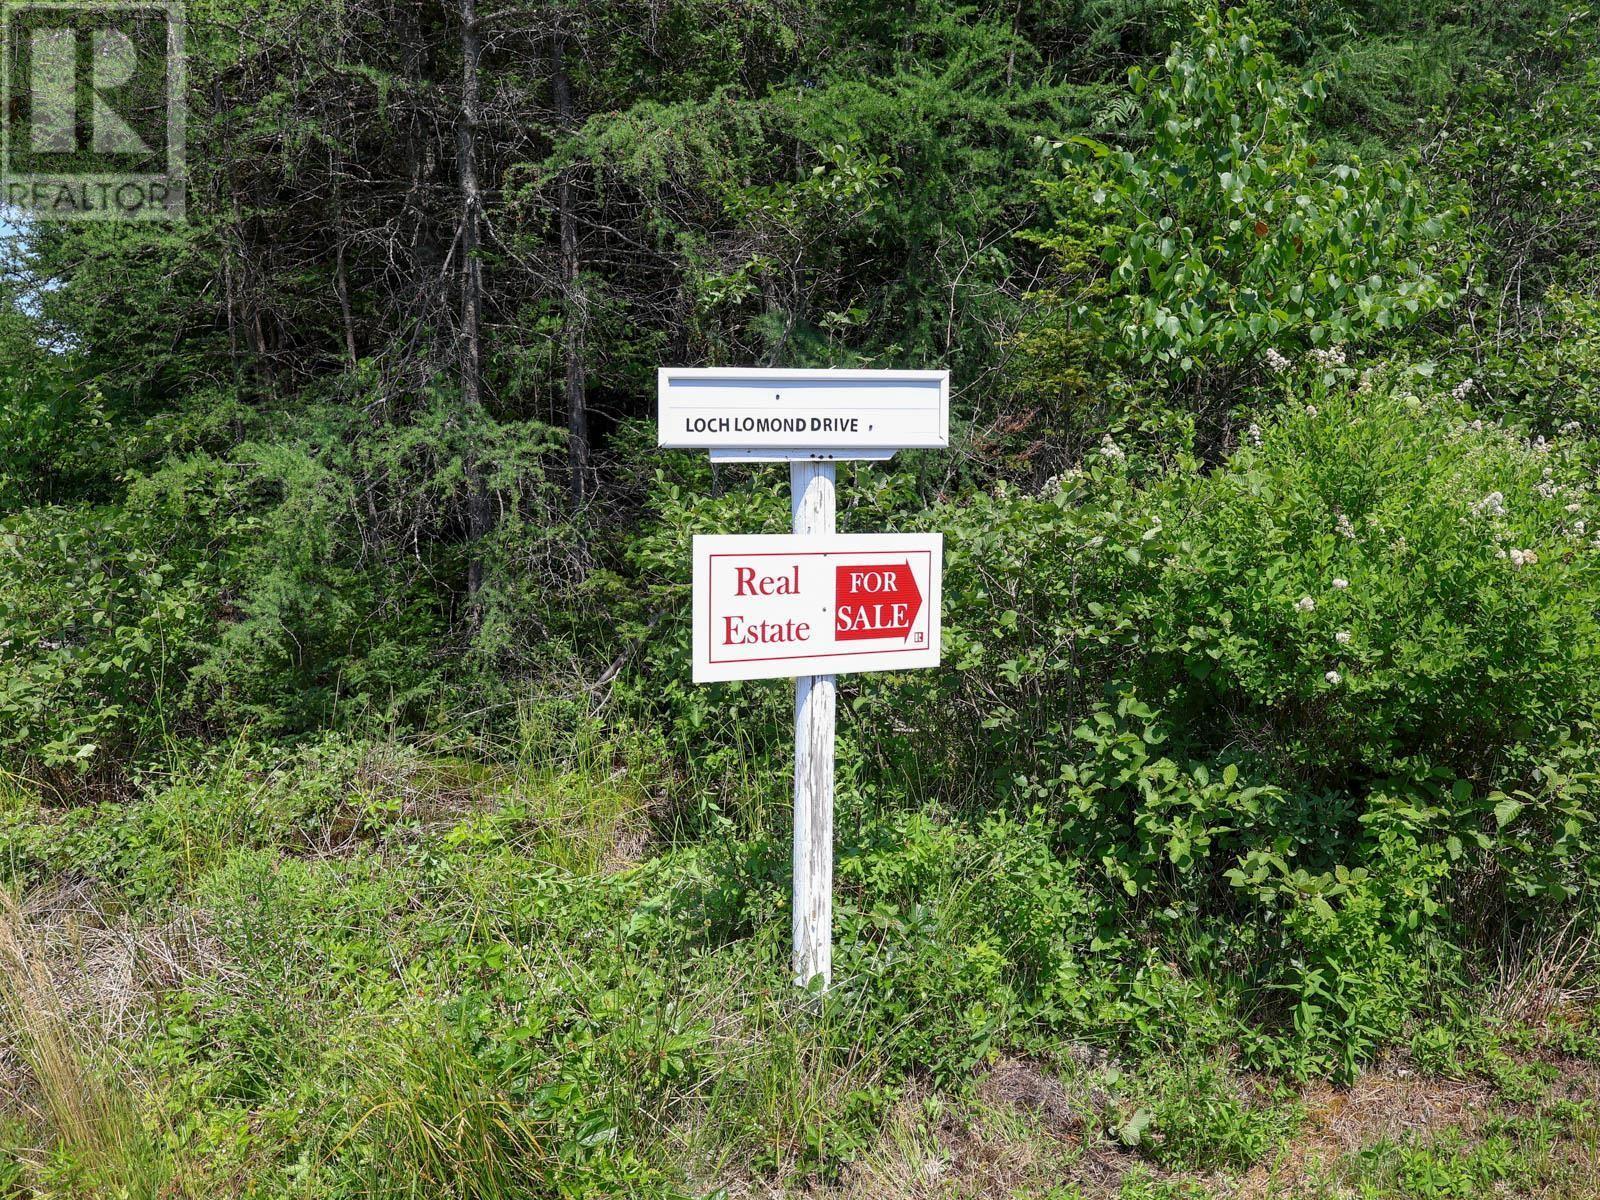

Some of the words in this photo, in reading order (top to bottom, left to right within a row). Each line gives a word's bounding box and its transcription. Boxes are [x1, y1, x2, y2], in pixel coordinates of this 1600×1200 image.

[686, 417, 730, 433] LOCH
[734, 417, 807, 433] LOMOND
[810, 417, 859, 433] DRIVE
[734, 565, 801, 597] Real
[849, 571, 899, 594] FOR
[722, 615, 811, 646] Estate
[836, 603, 910, 632] SALE
